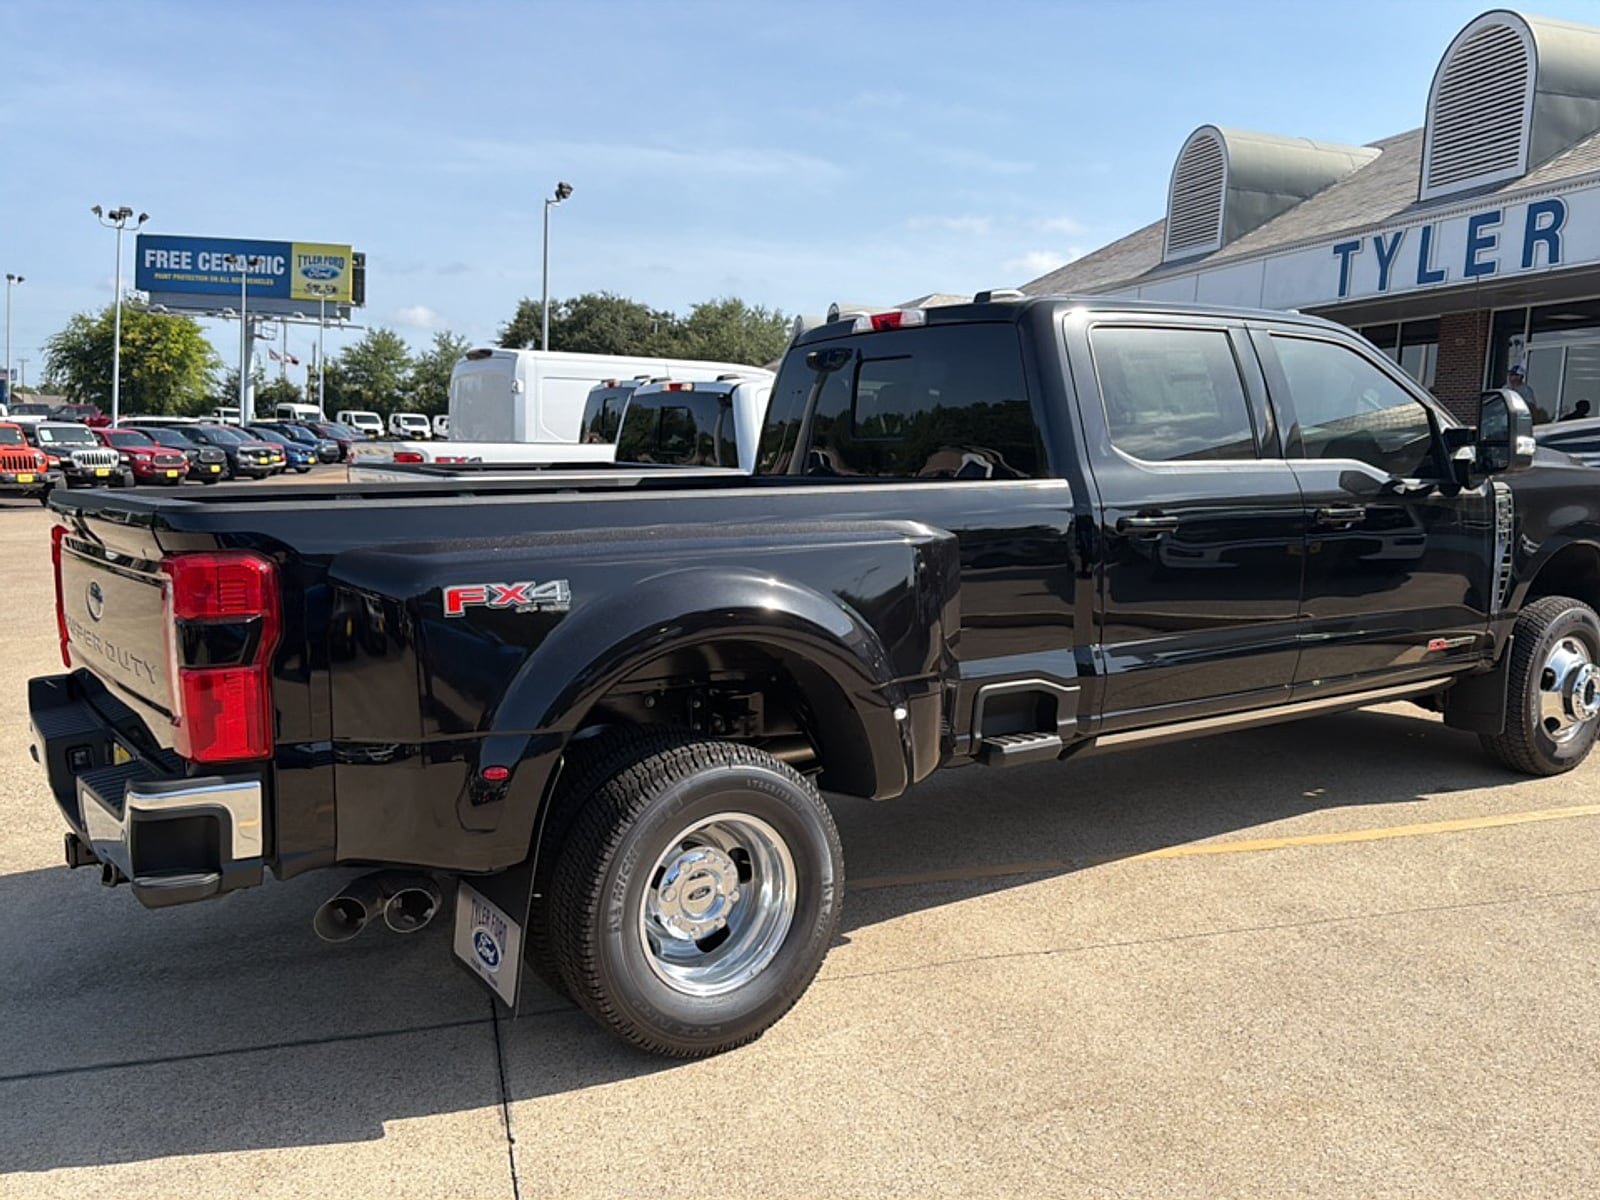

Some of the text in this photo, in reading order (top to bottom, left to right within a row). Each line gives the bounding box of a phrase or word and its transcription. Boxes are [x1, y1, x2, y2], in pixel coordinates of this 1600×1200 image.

[144, 249, 285, 275] FREE CERAMIC
[1332, 198, 1567, 298] TYLER
[443, 579, 571, 618] FX4
[105, 641, 158, 685] DUTY
